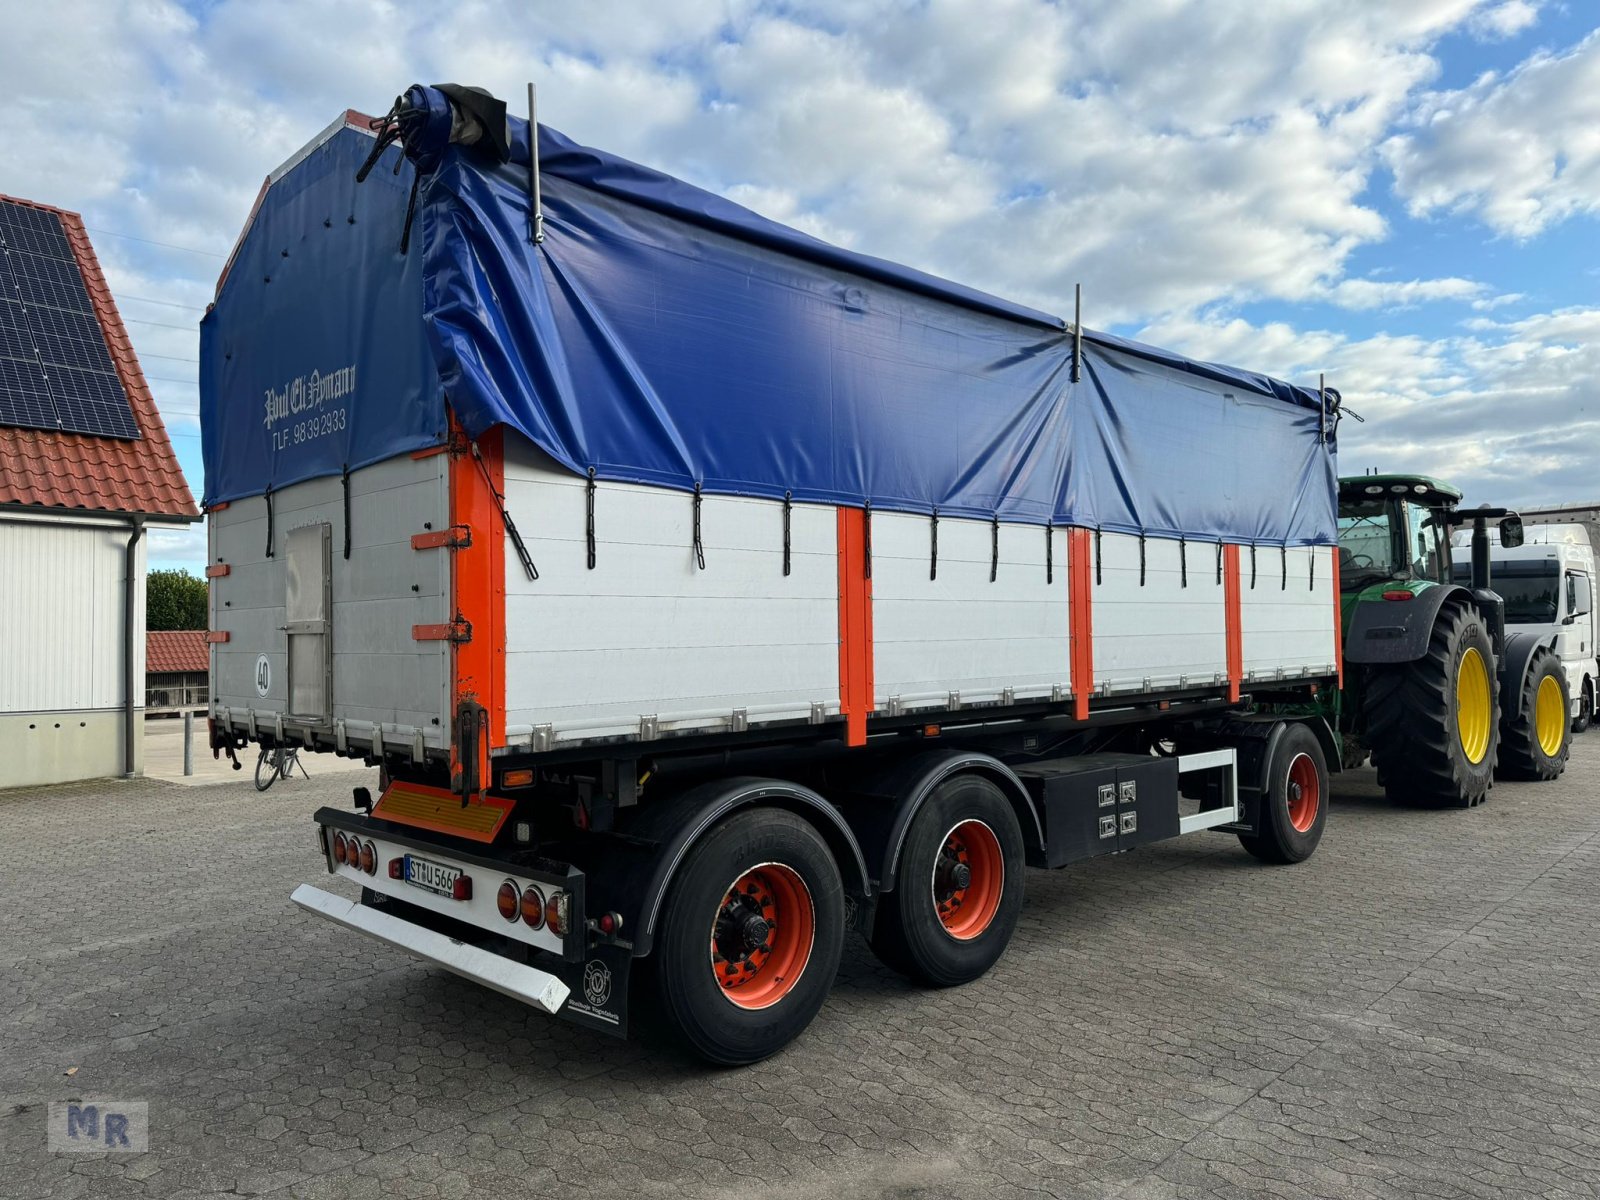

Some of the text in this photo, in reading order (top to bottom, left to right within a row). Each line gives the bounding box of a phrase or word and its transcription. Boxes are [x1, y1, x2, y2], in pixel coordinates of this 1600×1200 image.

[273, 428, 291, 452] TLF.
[258, 661, 269, 690] 40
[426, 864, 433, 885] U
